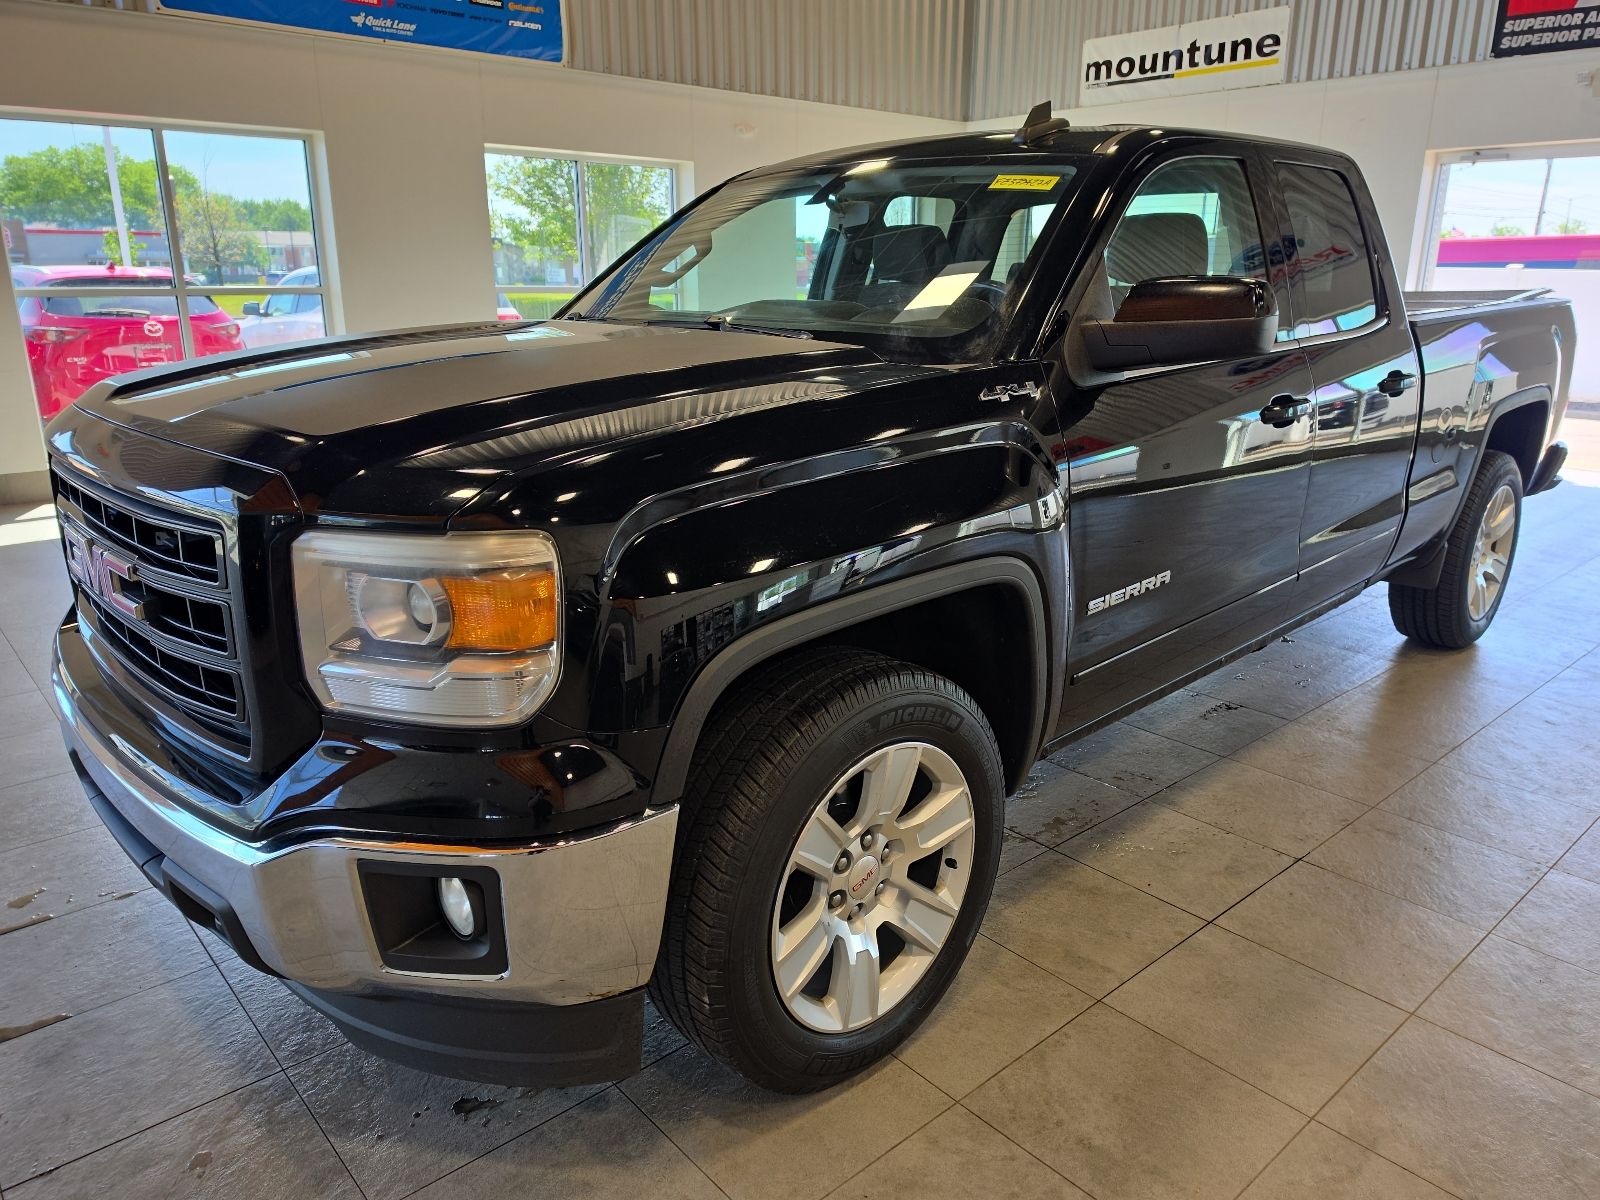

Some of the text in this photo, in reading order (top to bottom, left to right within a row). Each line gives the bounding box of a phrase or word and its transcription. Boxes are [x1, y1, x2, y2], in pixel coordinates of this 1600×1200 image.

[365, 15, 417, 32] Quick Lane
[1503, 13, 1584, 33] SUPERIOR
[1500, 29, 1582, 49] SUPERIOR
[1085, 33, 1281, 83] mountune
[64, 523, 145, 619] GMC
[1086, 570, 1171, 616] SIERRA
[881, 706, 960, 730] MICHELIN
[853, 863, 879, 892] GMC
